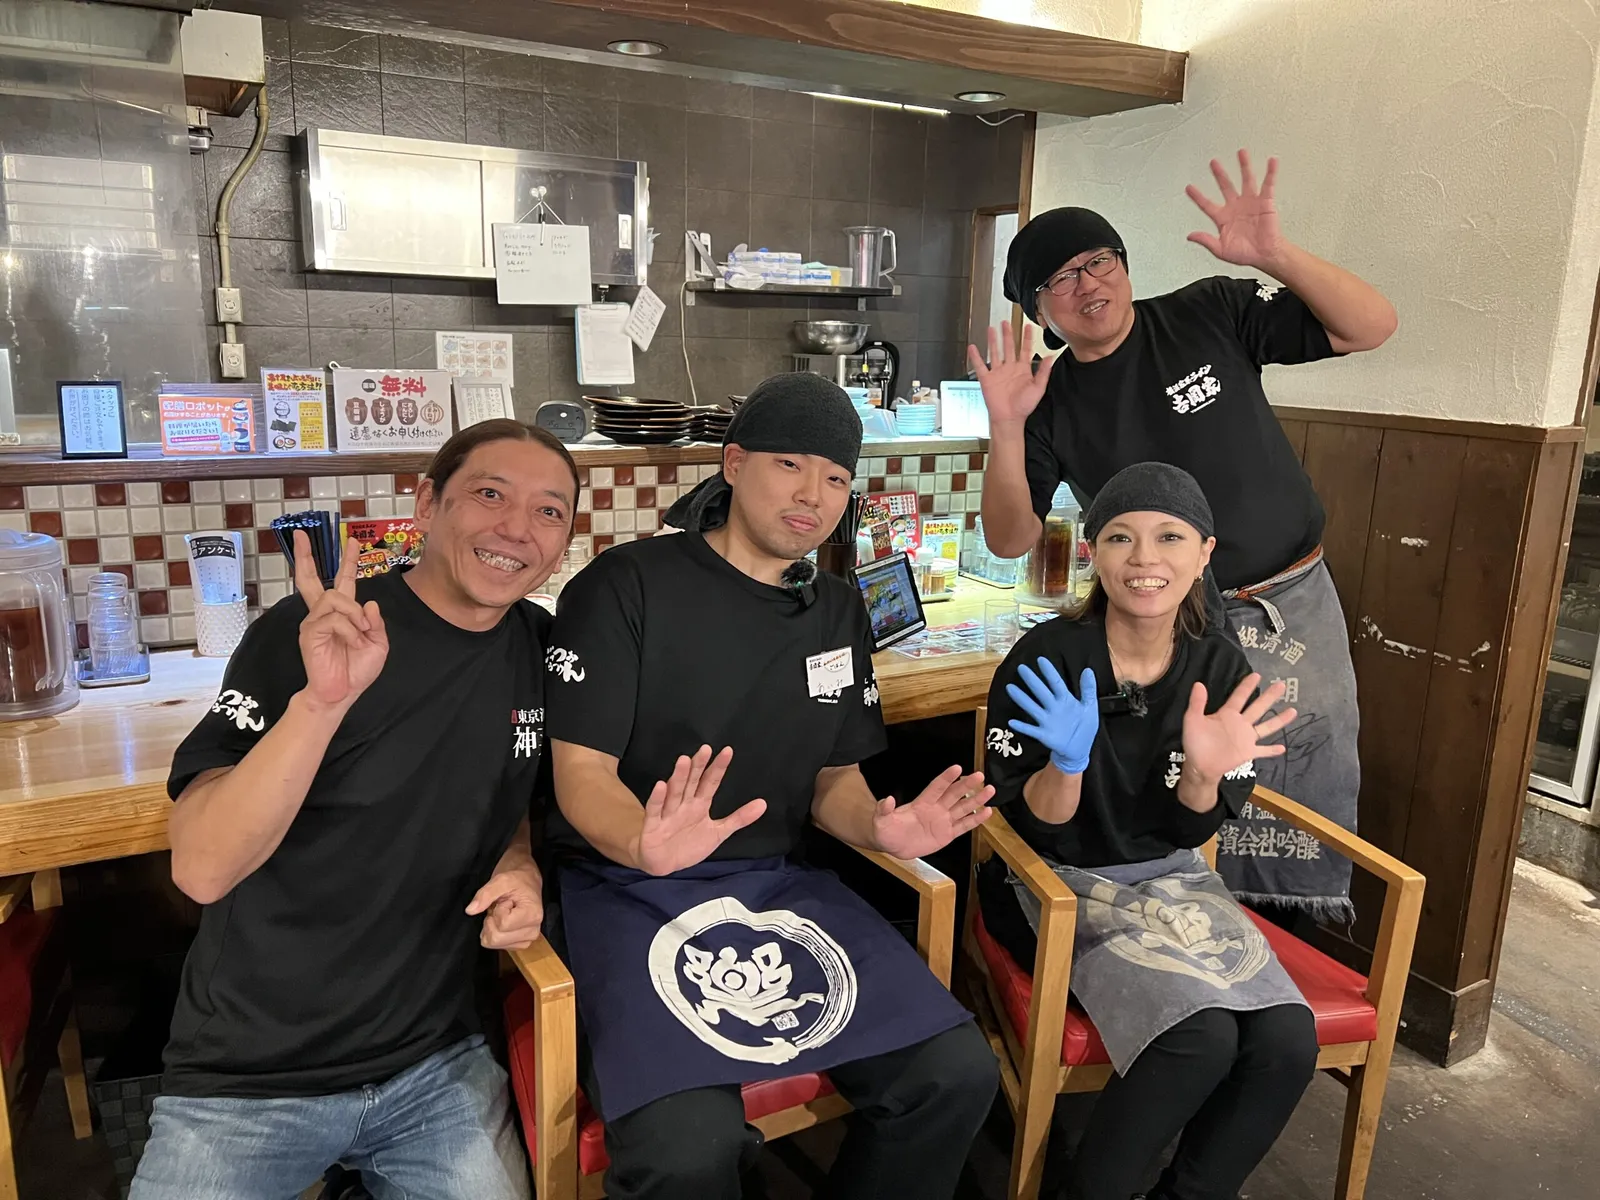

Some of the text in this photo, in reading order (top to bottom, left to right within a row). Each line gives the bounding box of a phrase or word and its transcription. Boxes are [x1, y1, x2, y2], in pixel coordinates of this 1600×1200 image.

[378, 375, 426, 398] 無料
[350, 426, 443, 440] 遠慮なくお申し付けください
[387, 521, 415, 532] ラーメン
[197, 546, 236, 555] アンケート
[512, 726, 543, 759] 神
[1217, 824, 1320, 861] 資会社吟醸
